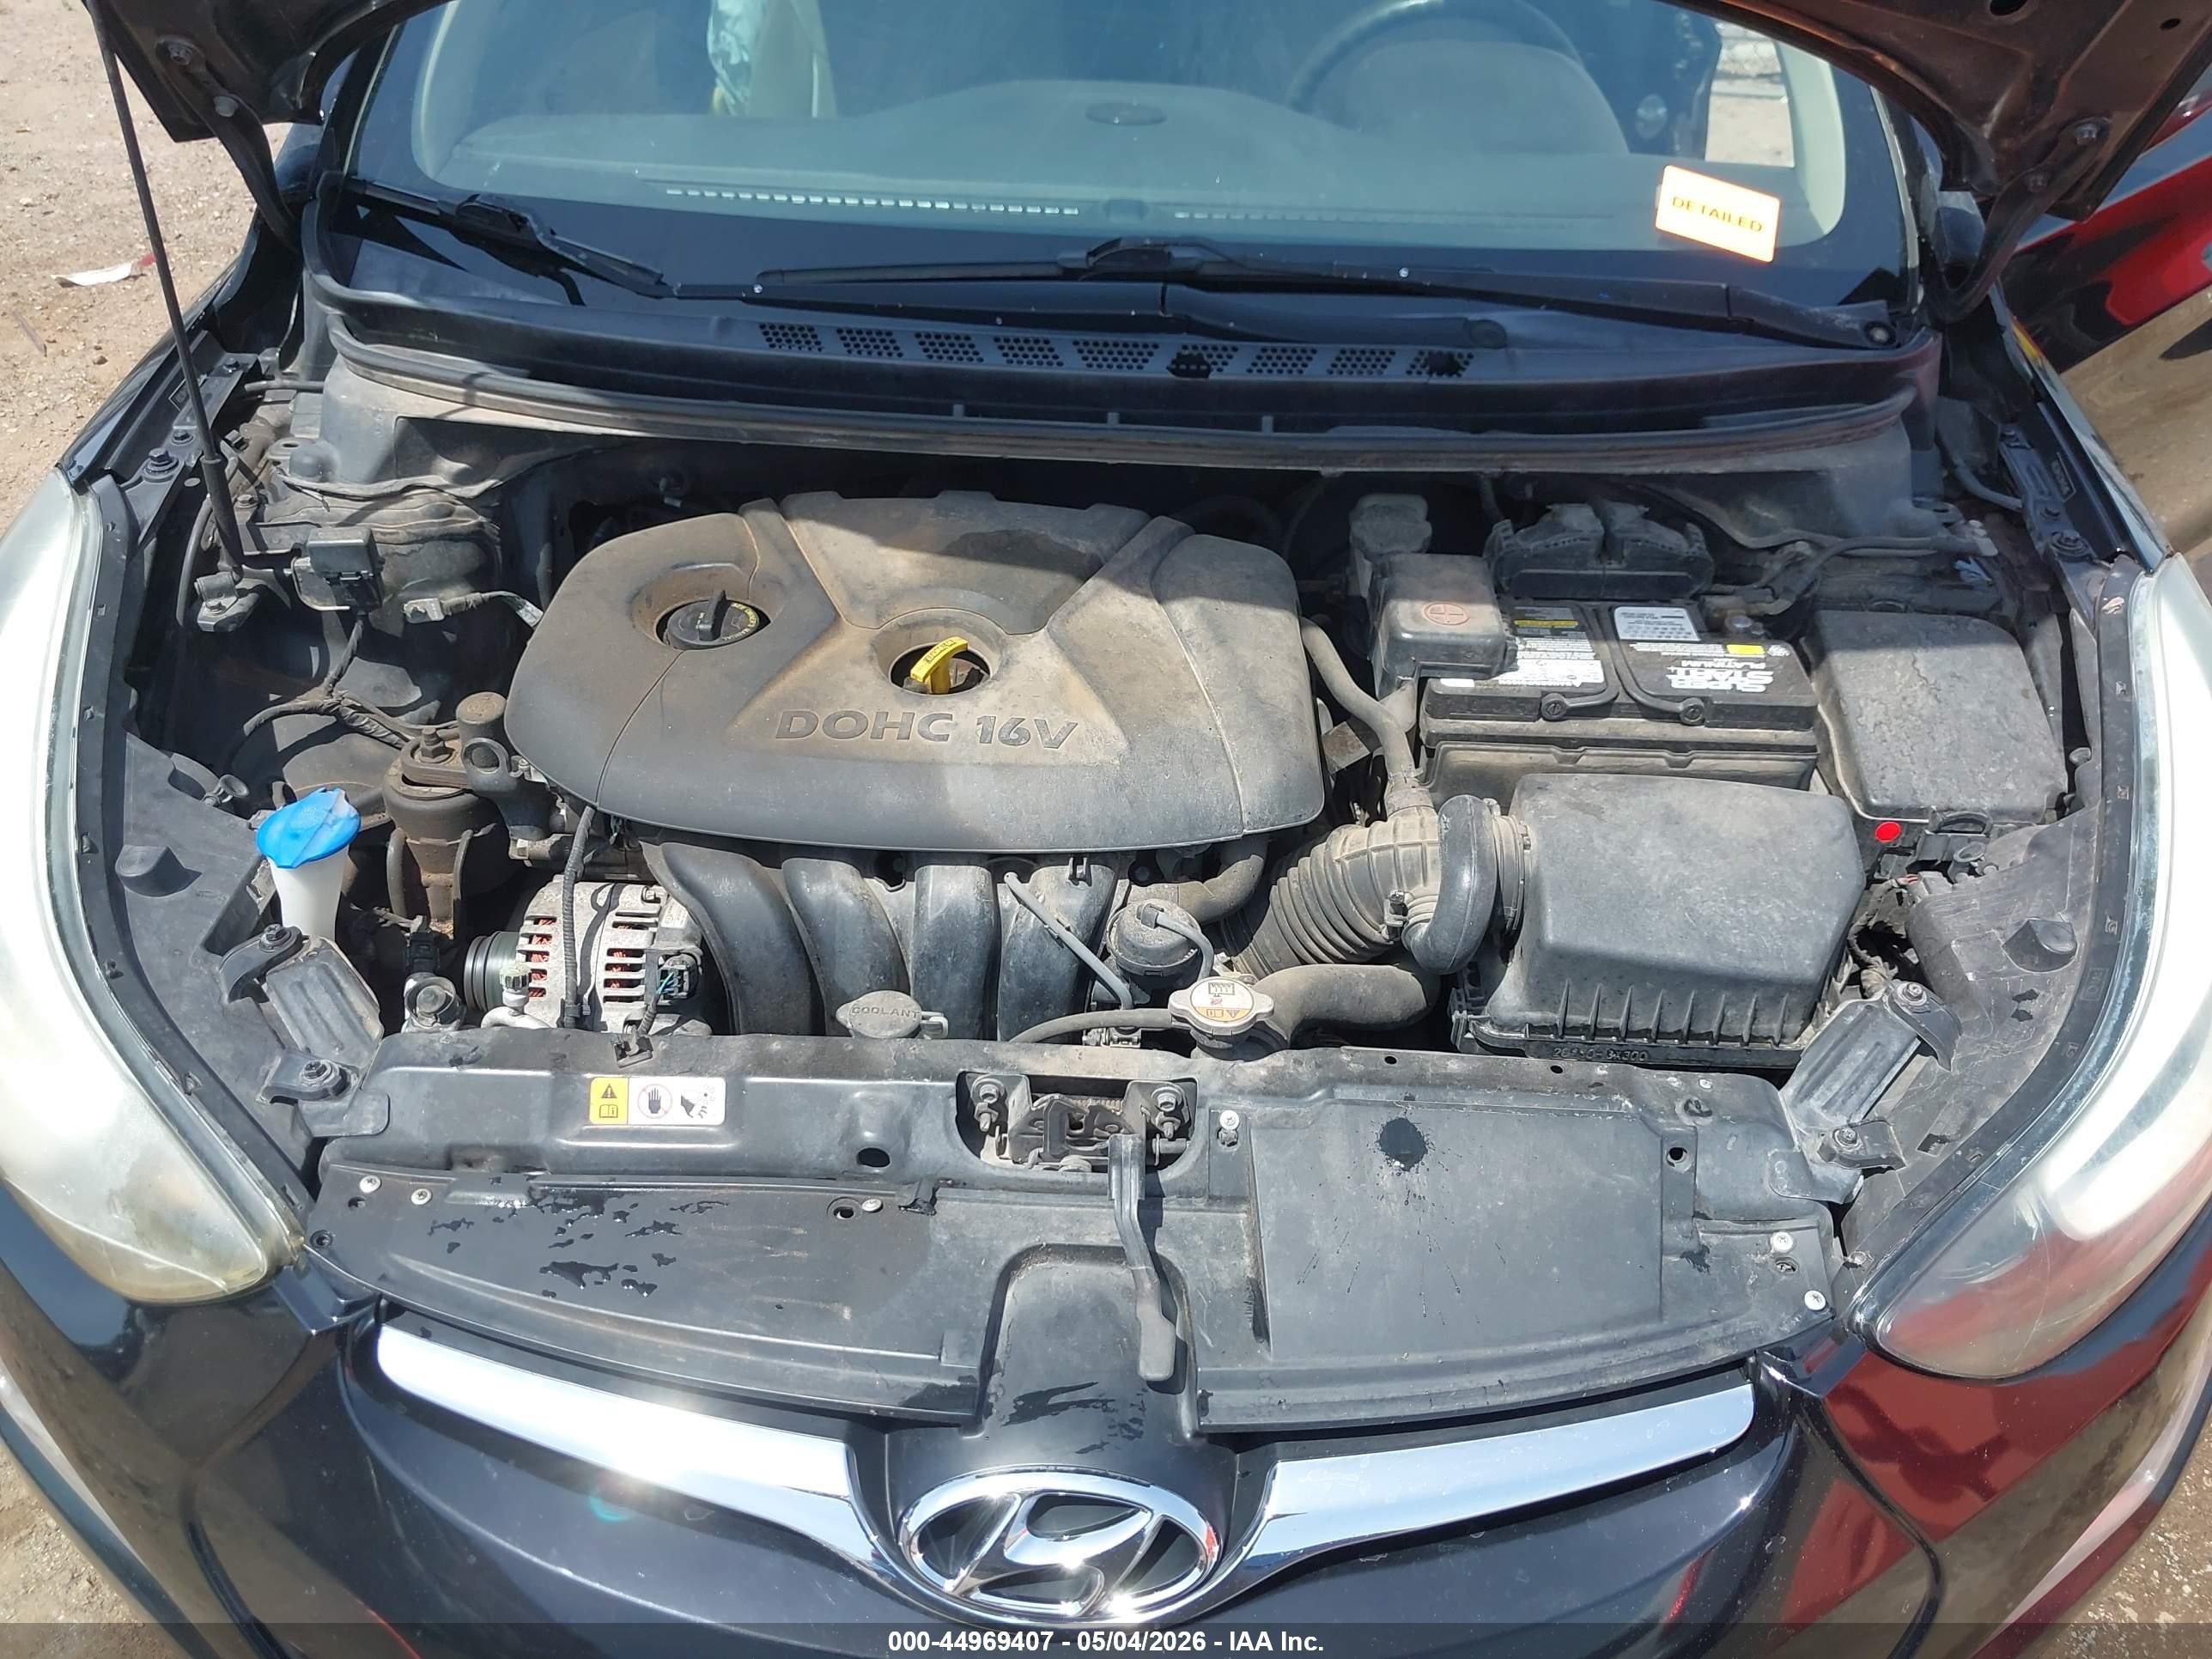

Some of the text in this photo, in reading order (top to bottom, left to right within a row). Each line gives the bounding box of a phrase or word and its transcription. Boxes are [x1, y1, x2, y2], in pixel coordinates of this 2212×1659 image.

[1671, 196, 1763, 233] DETAILED
[775, 709, 1079, 750] DOHC 16V
[851, 1006, 921, 1018] COOLANT
